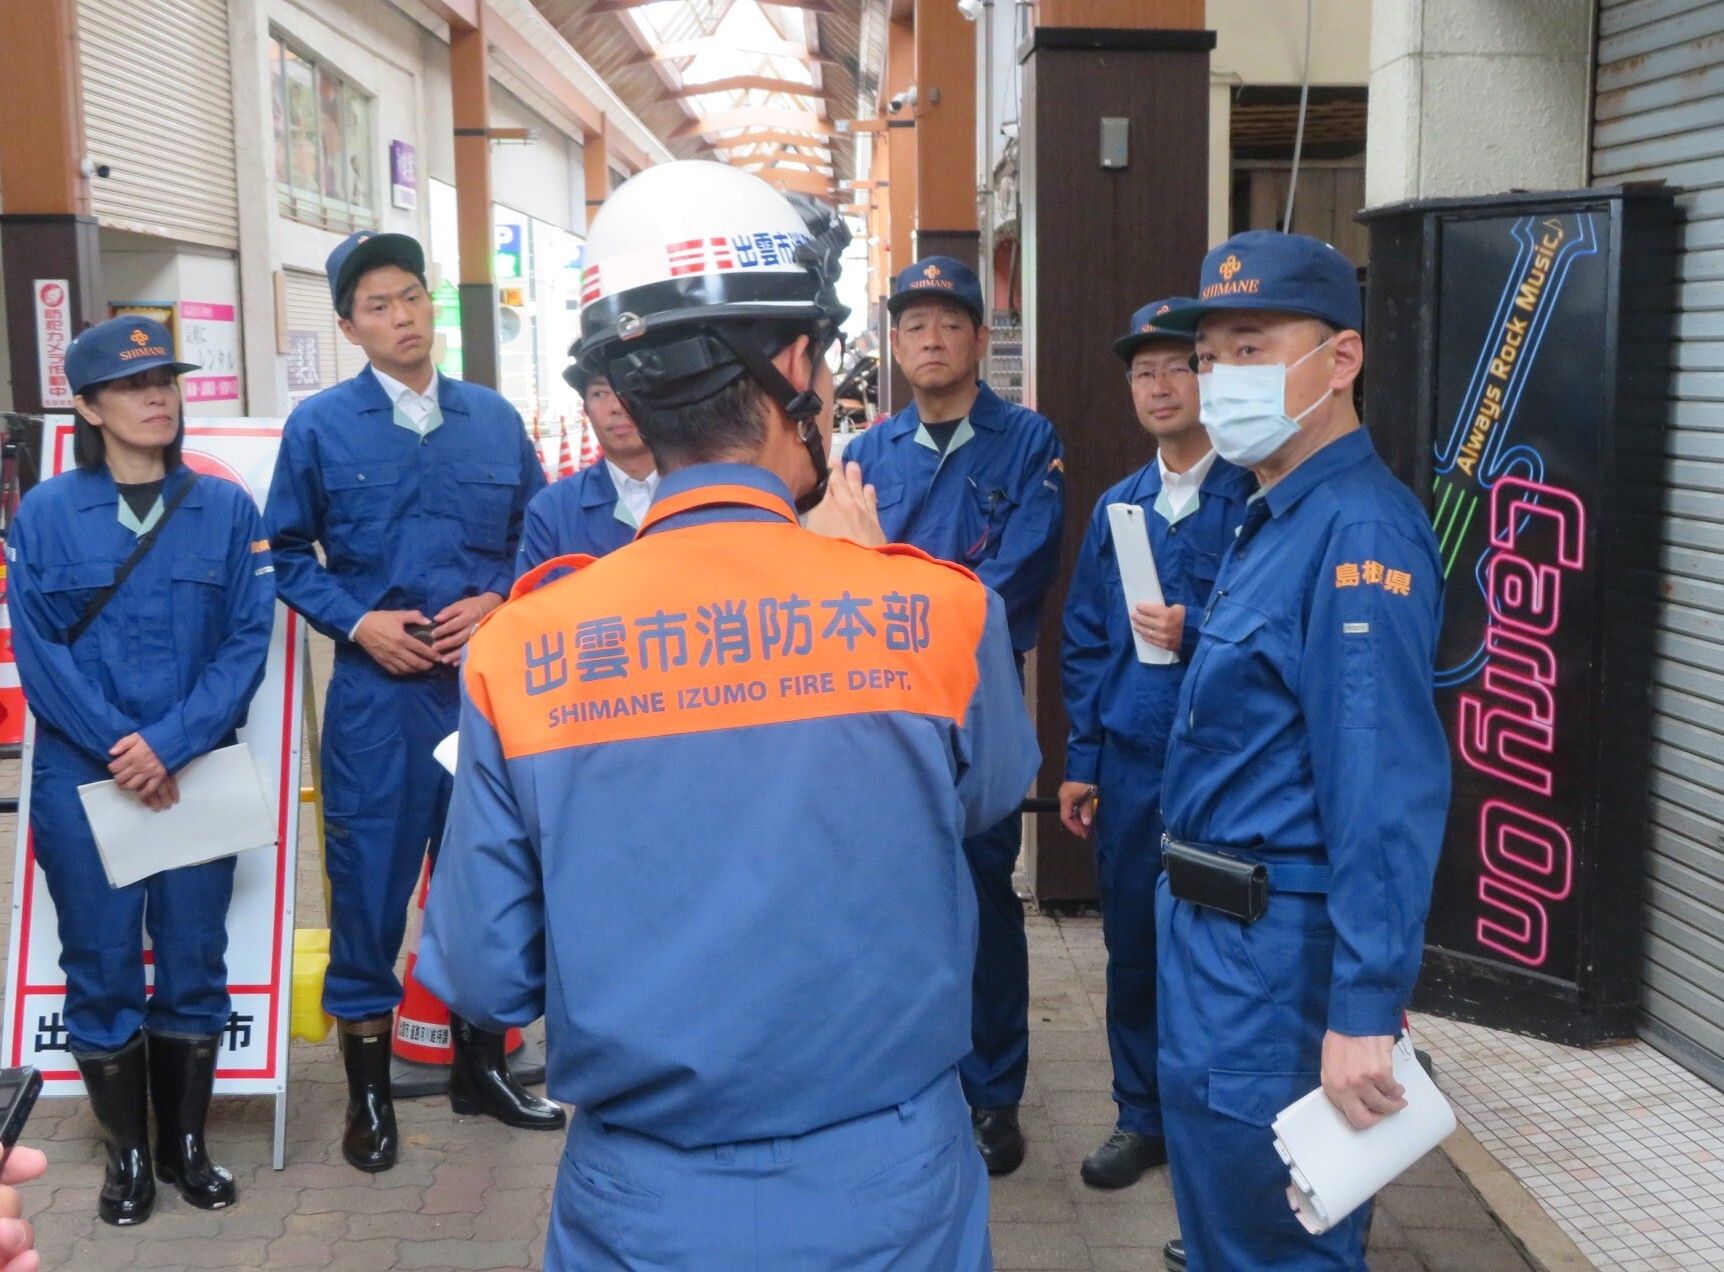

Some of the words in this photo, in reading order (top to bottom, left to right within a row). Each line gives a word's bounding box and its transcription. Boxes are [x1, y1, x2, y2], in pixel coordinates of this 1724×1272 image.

[910, 280, 953, 289] SHIMANE
[1202, 279, 1260, 300] SHIMANE
[119, 347, 167, 360] SHIMANE
[1457, 384, 1500, 476] Always
[1490, 317, 1528, 379] Rock
[1516, 231, 1559, 311] Music
[1335, 560, 1412, 596] 島根県
[524, 591, 931, 697] 出雲市消防本部
[547, 692, 666, 729] SHIMANE
[677, 681, 767, 710] IZUMO
[780, 672, 836, 698] FIRE
[848, 669, 912, 692] DEPT.
